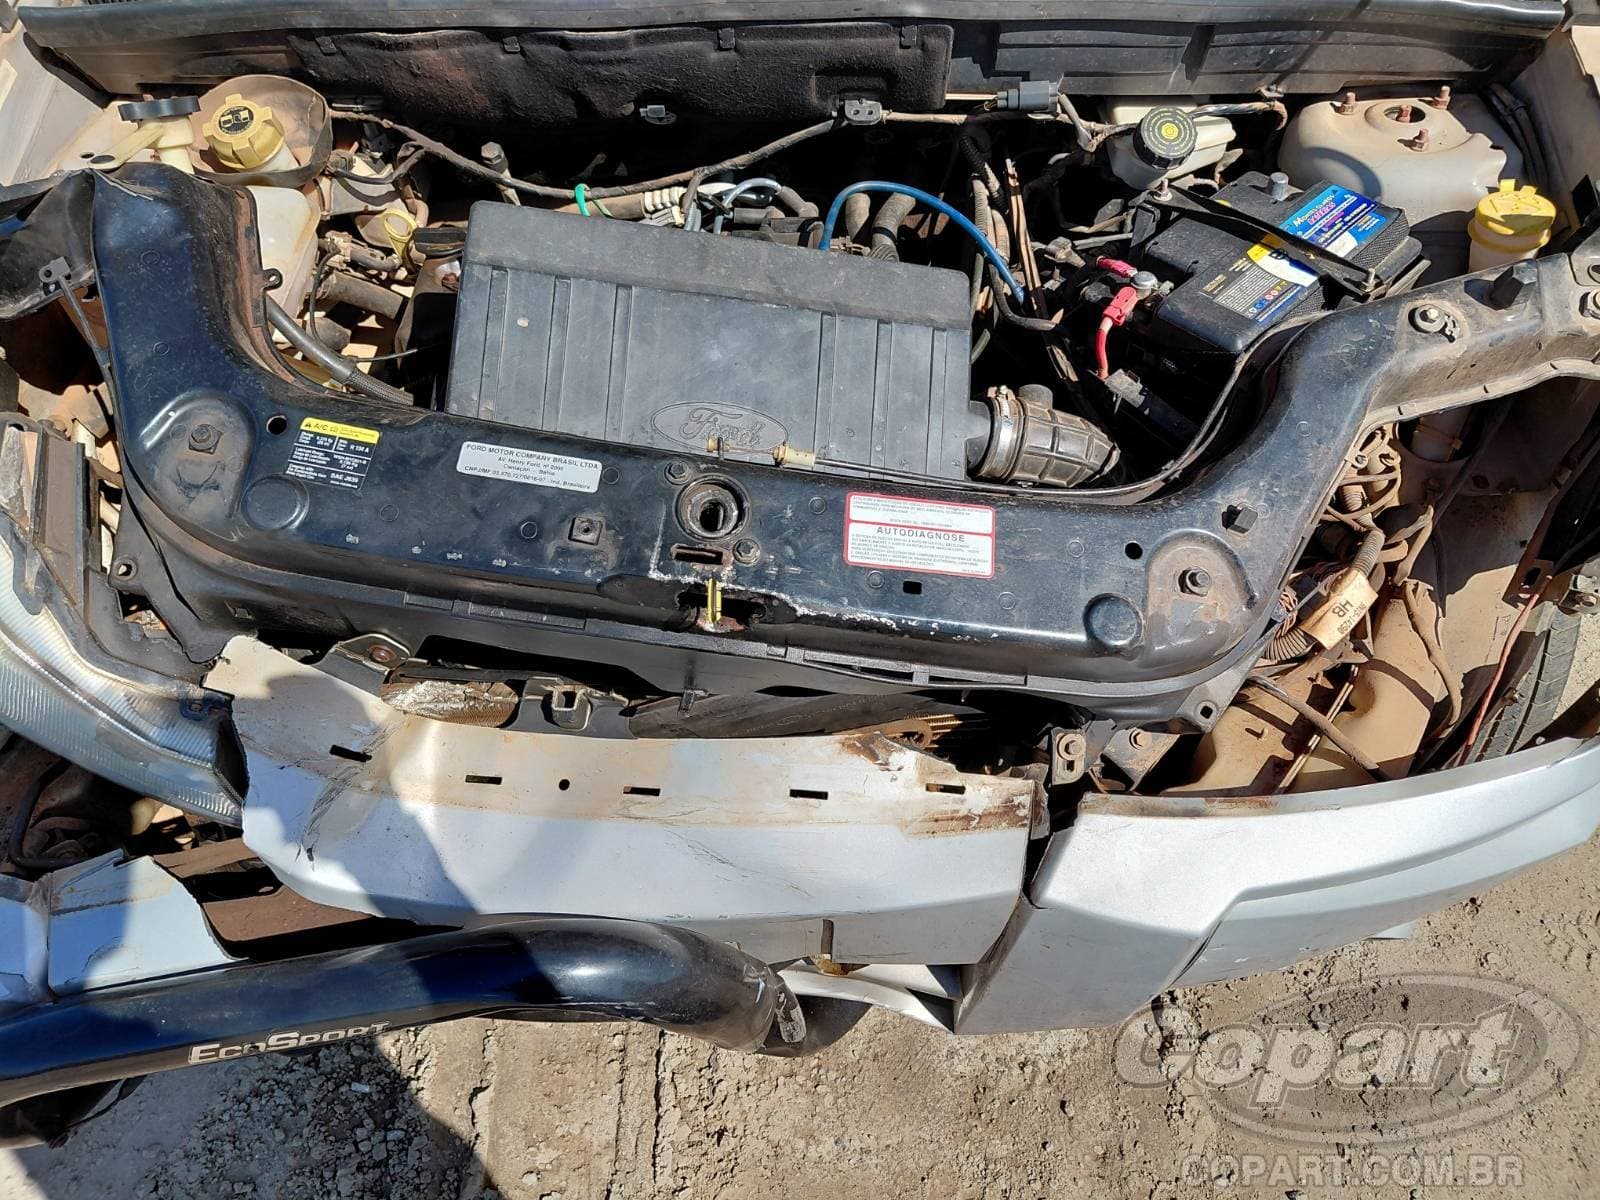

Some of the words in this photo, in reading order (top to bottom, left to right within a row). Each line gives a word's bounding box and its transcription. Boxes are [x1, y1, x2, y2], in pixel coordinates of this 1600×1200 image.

[466, 444, 486, 452] FORD
[488, 447, 514, 456] MOTOR
[515, 451, 550, 461] COMPANY
[552, 457, 578, 466] BRASIL
[876, 526, 966, 543] AUTODIAGNOSE
